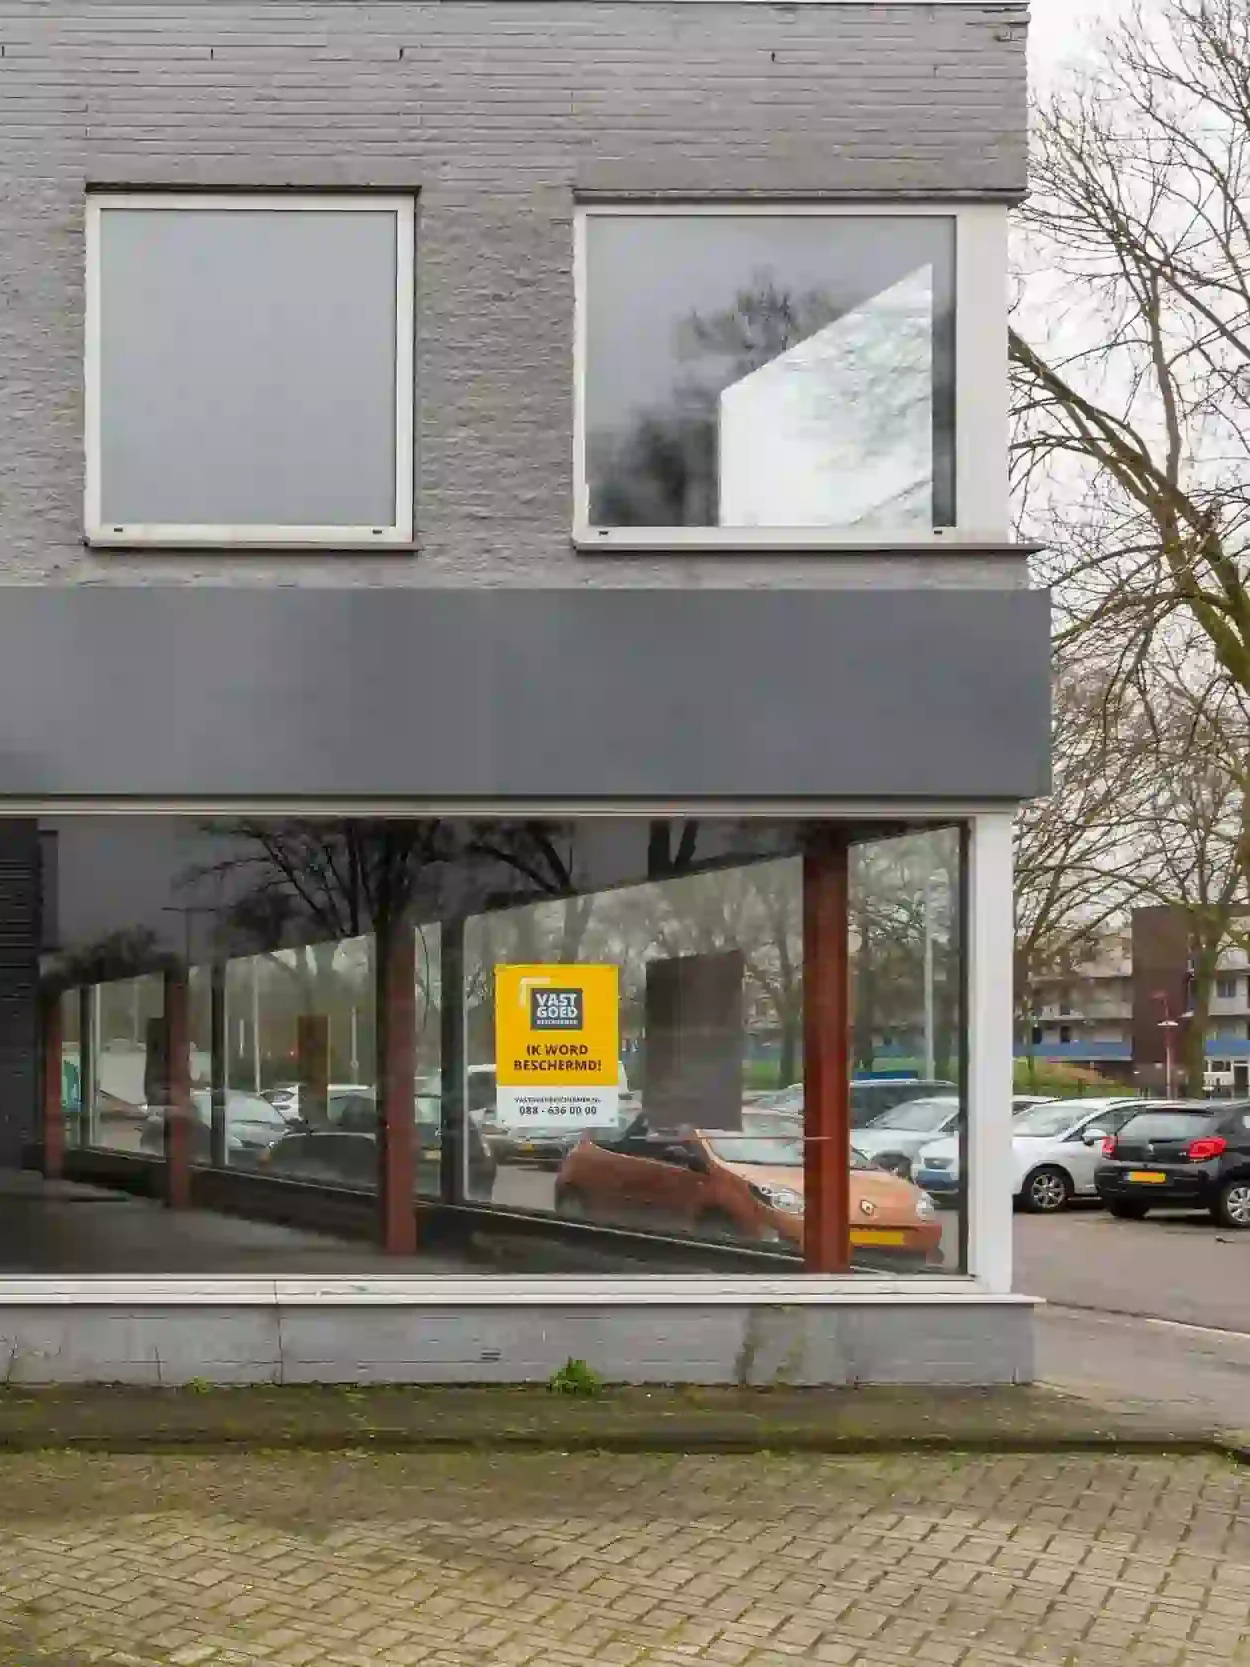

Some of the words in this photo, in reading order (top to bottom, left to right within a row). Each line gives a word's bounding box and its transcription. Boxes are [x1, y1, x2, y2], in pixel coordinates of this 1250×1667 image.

[535, 993, 577, 1006] VAST
[536, 1007, 578, 1018] GOED
[526, 1044, 541, 1056] IK
[546, 1044, 588, 1056] WORD
[514, 1060, 602, 1072] BESCHERMD!
[519, 1106, 538, 1115] 088
[569, 1106, 582, 1115] 00
[584, 1106, 597, 1115] 00
